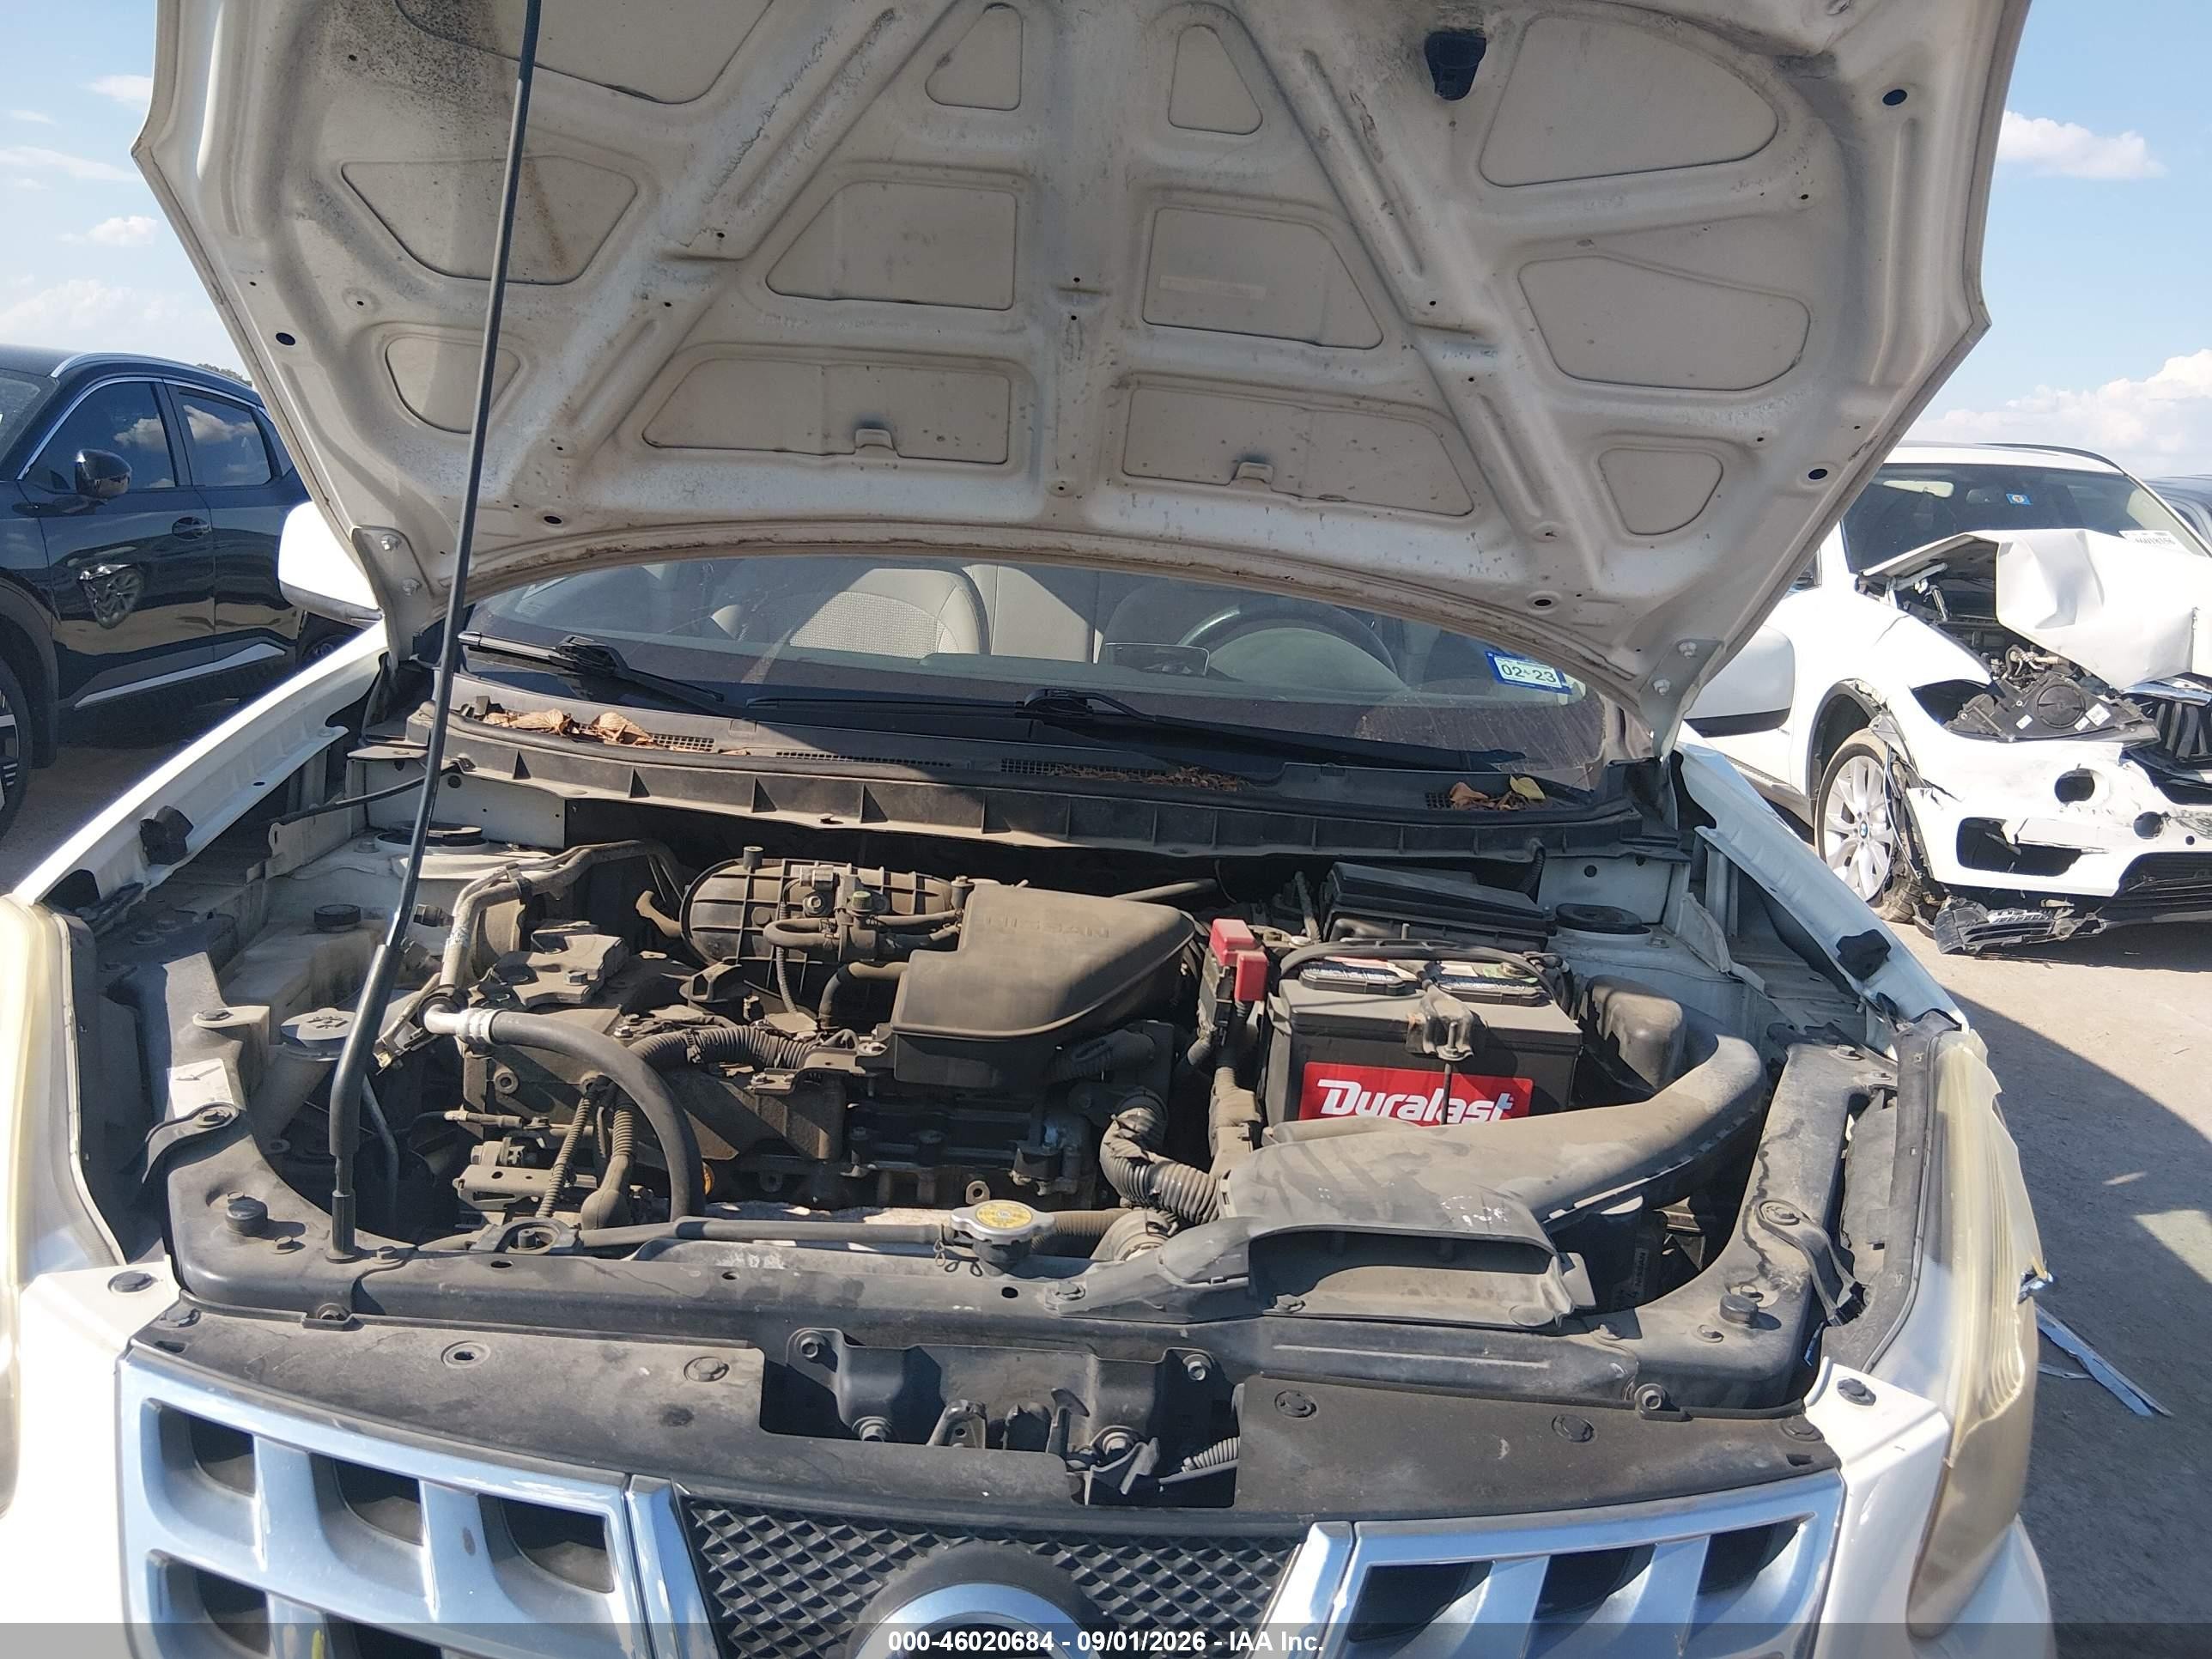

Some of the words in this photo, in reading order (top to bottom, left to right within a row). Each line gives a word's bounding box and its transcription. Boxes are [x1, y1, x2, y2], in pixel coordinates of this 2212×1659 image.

[1501, 664, 1525, 678] 02
[1532, 669, 1557, 683] 23
[1317, 1079, 1515, 1124] Duralast
